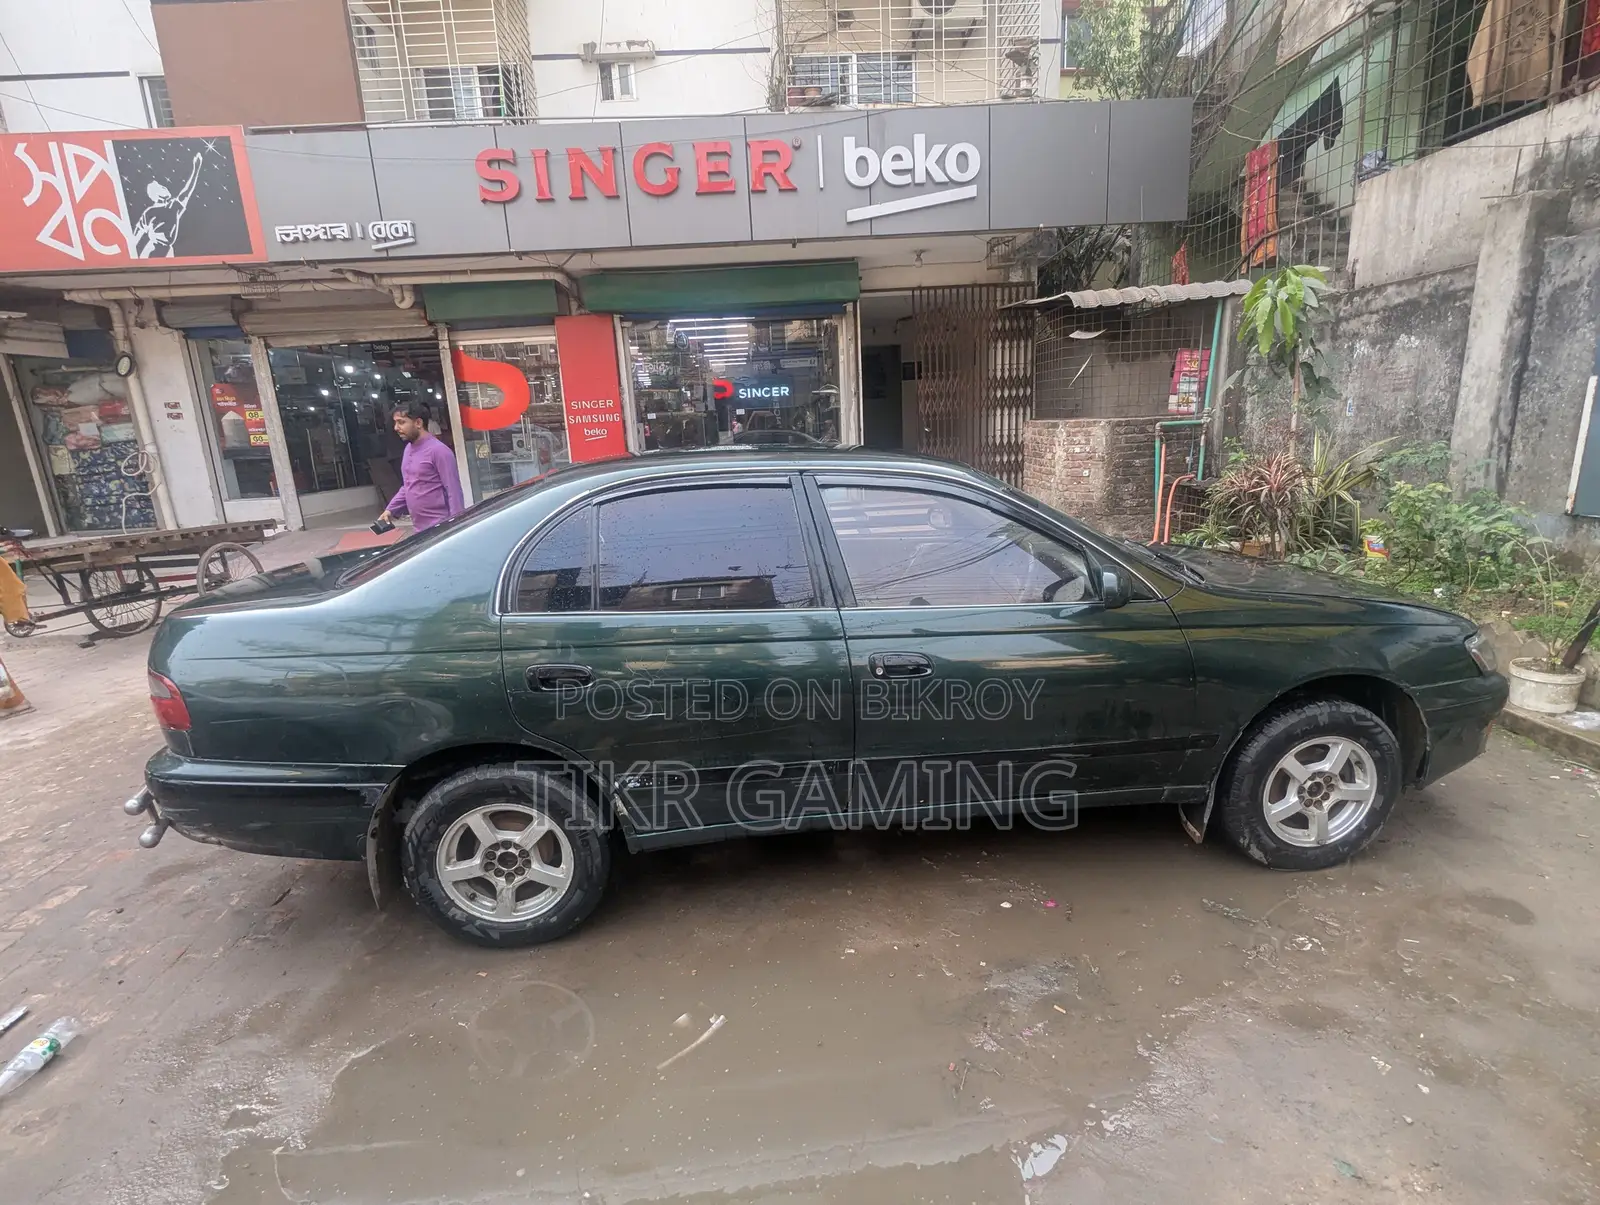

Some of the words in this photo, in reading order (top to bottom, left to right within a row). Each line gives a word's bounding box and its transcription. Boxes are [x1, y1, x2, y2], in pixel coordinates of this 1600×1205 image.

[843, 133, 982, 188] beko
[475, 138, 798, 203] SINGER
[275, 222, 352, 242] সিঙ্গার
[368, 219, 415, 241] বেকো
[738, 386, 790, 399] SINGER
[570, 399, 614, 410] SINGER
[568, 412, 620, 424] SAMSUNG
[583, 427, 608, 436] beko
